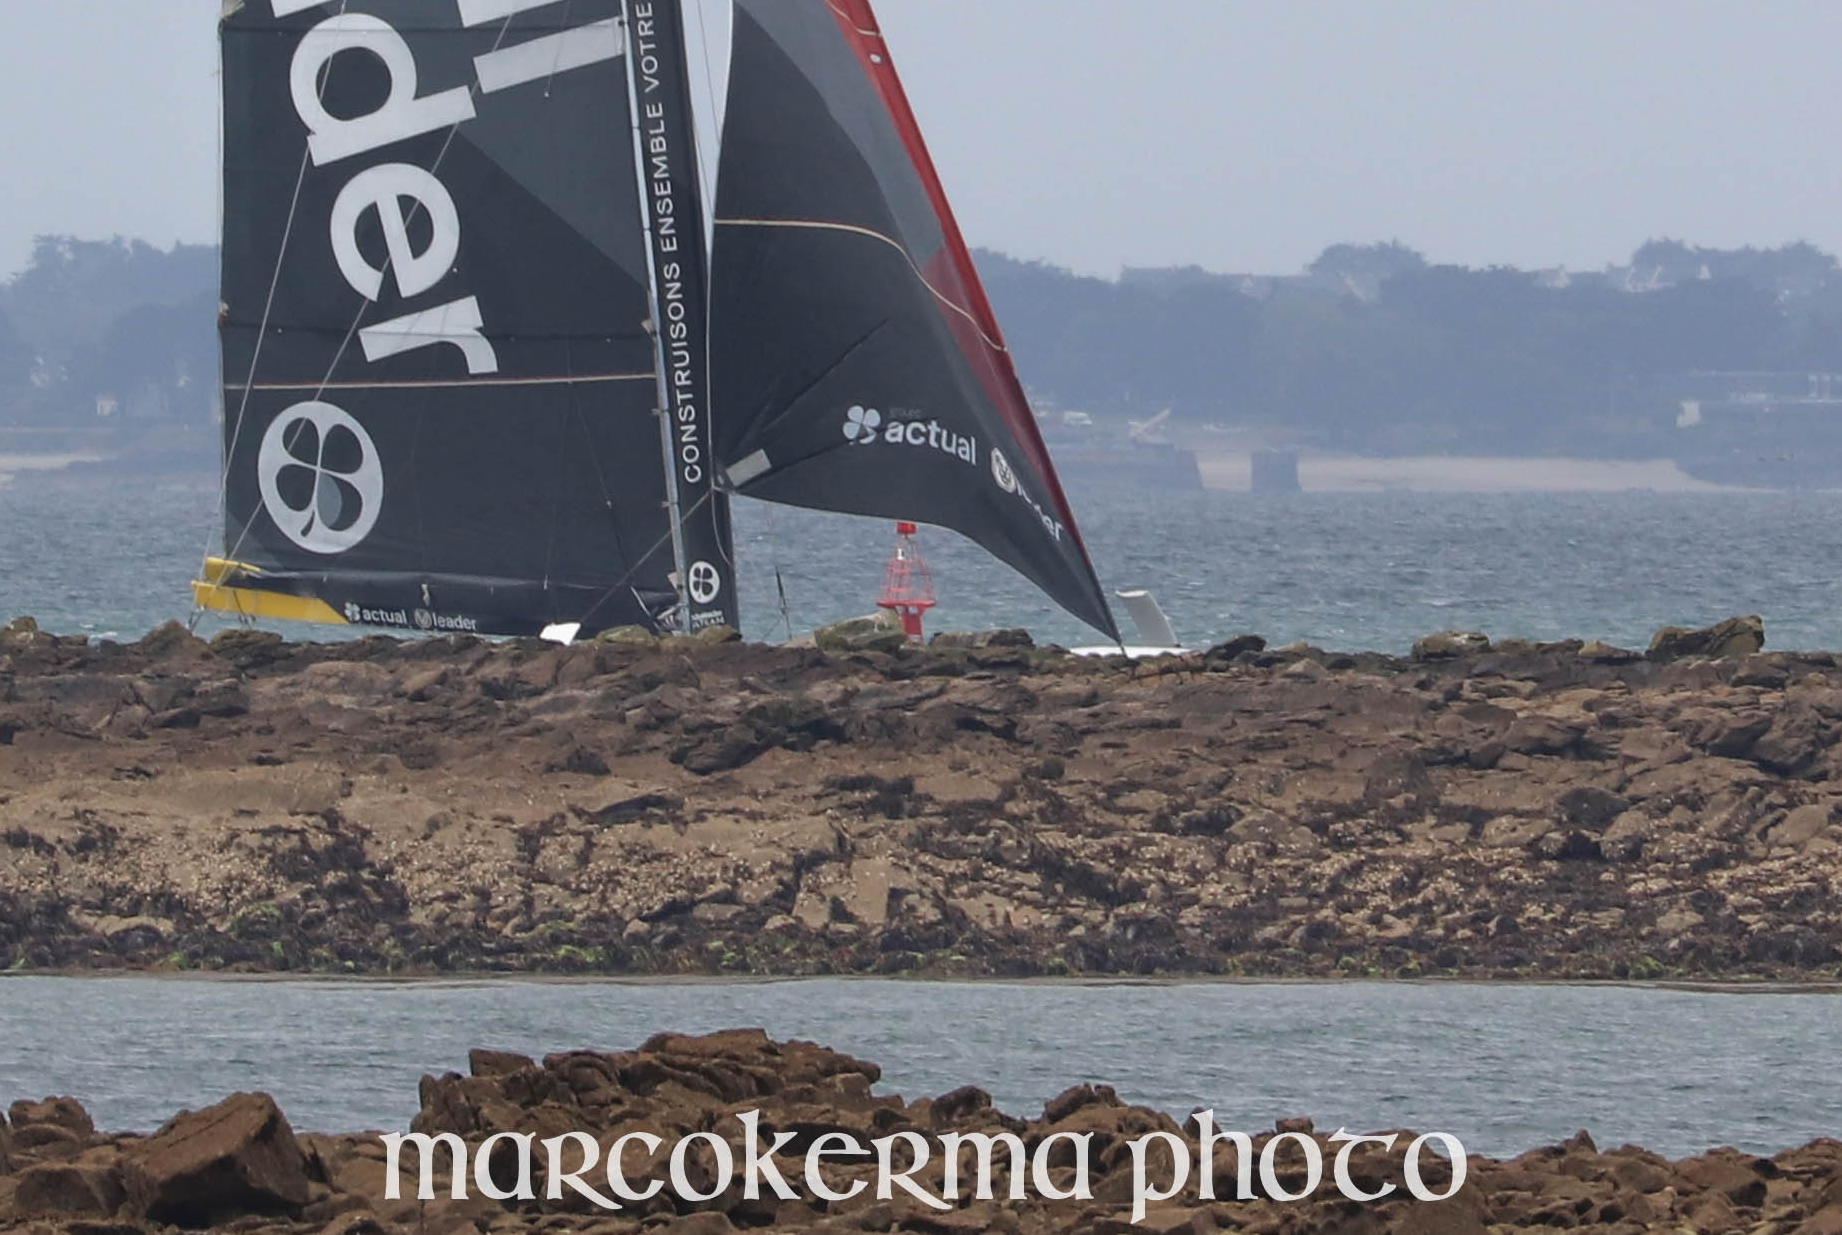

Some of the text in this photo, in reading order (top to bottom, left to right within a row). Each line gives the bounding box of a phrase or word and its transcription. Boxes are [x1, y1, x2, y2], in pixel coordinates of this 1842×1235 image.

[634, 2, 660, 94] VOTRE
[646, 102, 679, 253] ENSEMBLE
[664, 262, 703, 484] CONSTRUISONS
[884, 419, 977, 466] actual
[362, 609, 477, 631] actual leader
